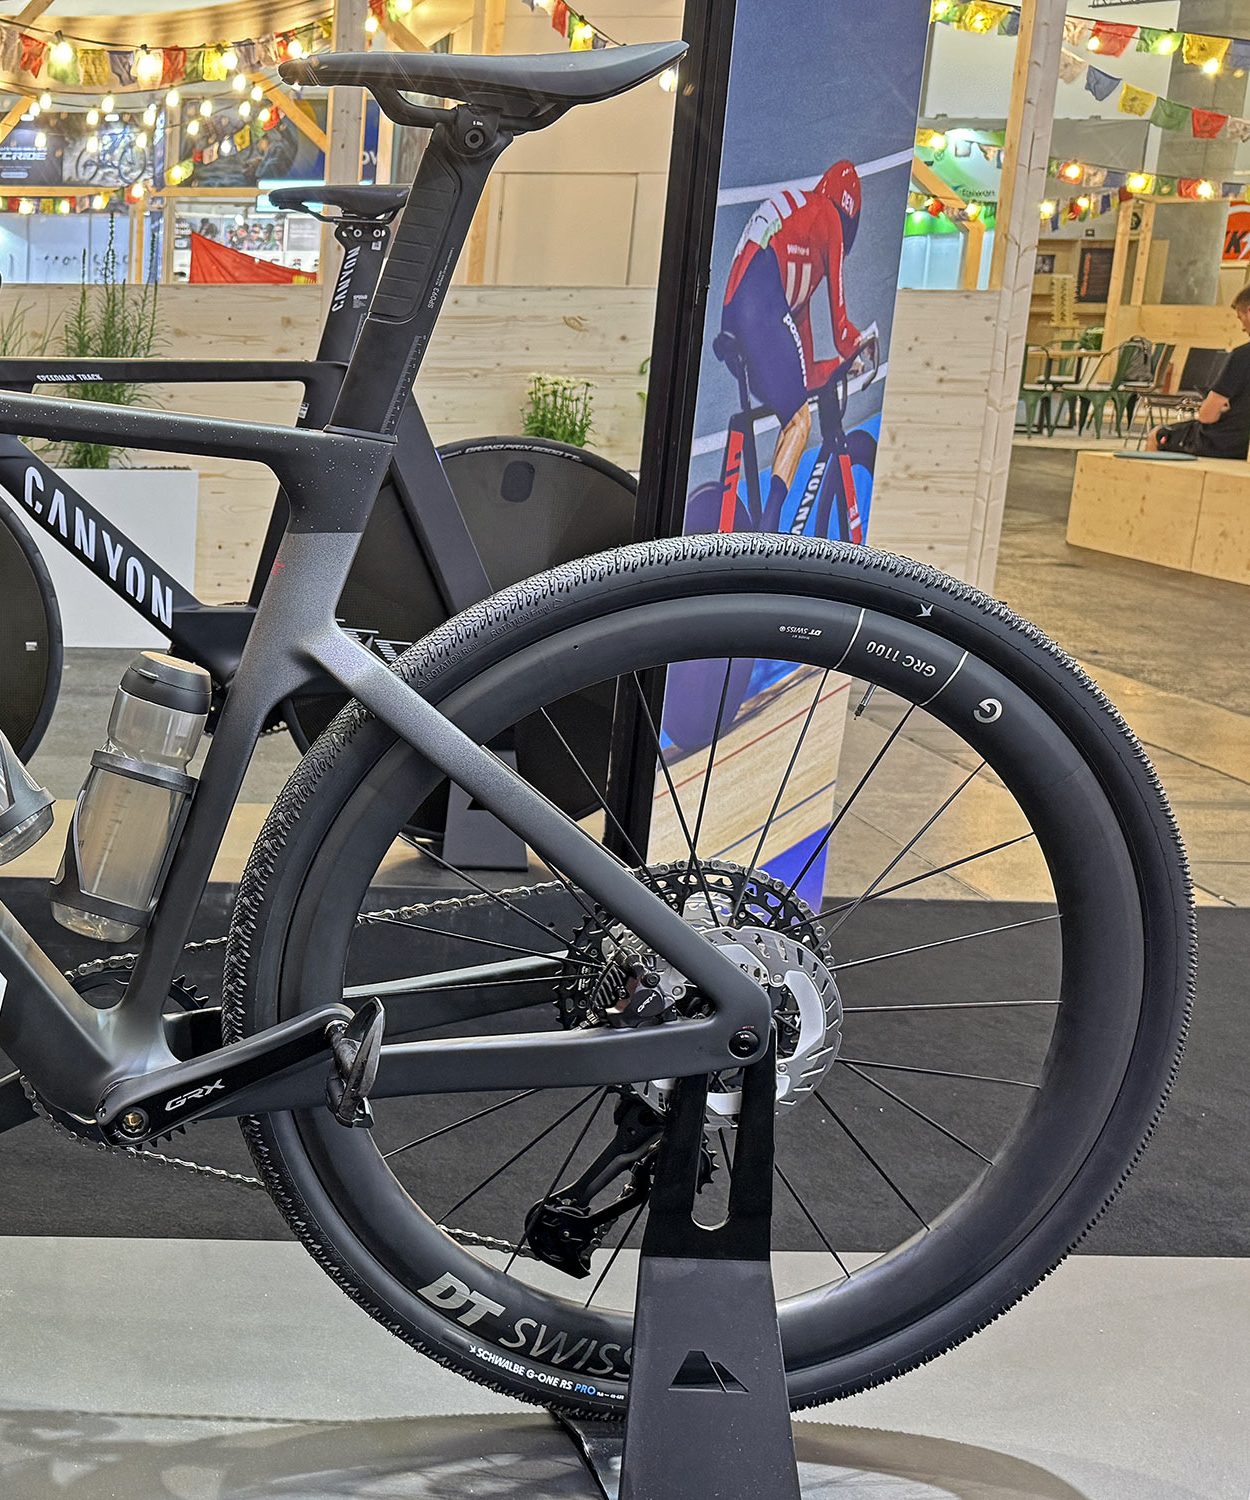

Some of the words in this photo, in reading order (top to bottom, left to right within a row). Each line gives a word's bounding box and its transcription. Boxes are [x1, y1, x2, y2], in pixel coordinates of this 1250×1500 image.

[331, 246, 361, 312] CANYON
[76, 373, 103, 381] TRACK
[465, 443, 504, 454] GRAND
[24, 465, 173, 630] CANYON
[490, 612, 530, 638] ROTATION
[808, 629, 823, 637] DT
[866, 641, 901, 663] 1100
[425, 651, 462, 682] ROTATION
[902, 655, 937, 678] GRC
[165, 1078, 225, 1111] GRX
[417, 1271, 506, 1327] DT
[476, 1348, 525, 1376] SCHWALBE
[525, 1369, 560, 1387] G-ONE
[560, 1379, 574, 1391] RS
[574, 1382, 597, 1395] PRO
